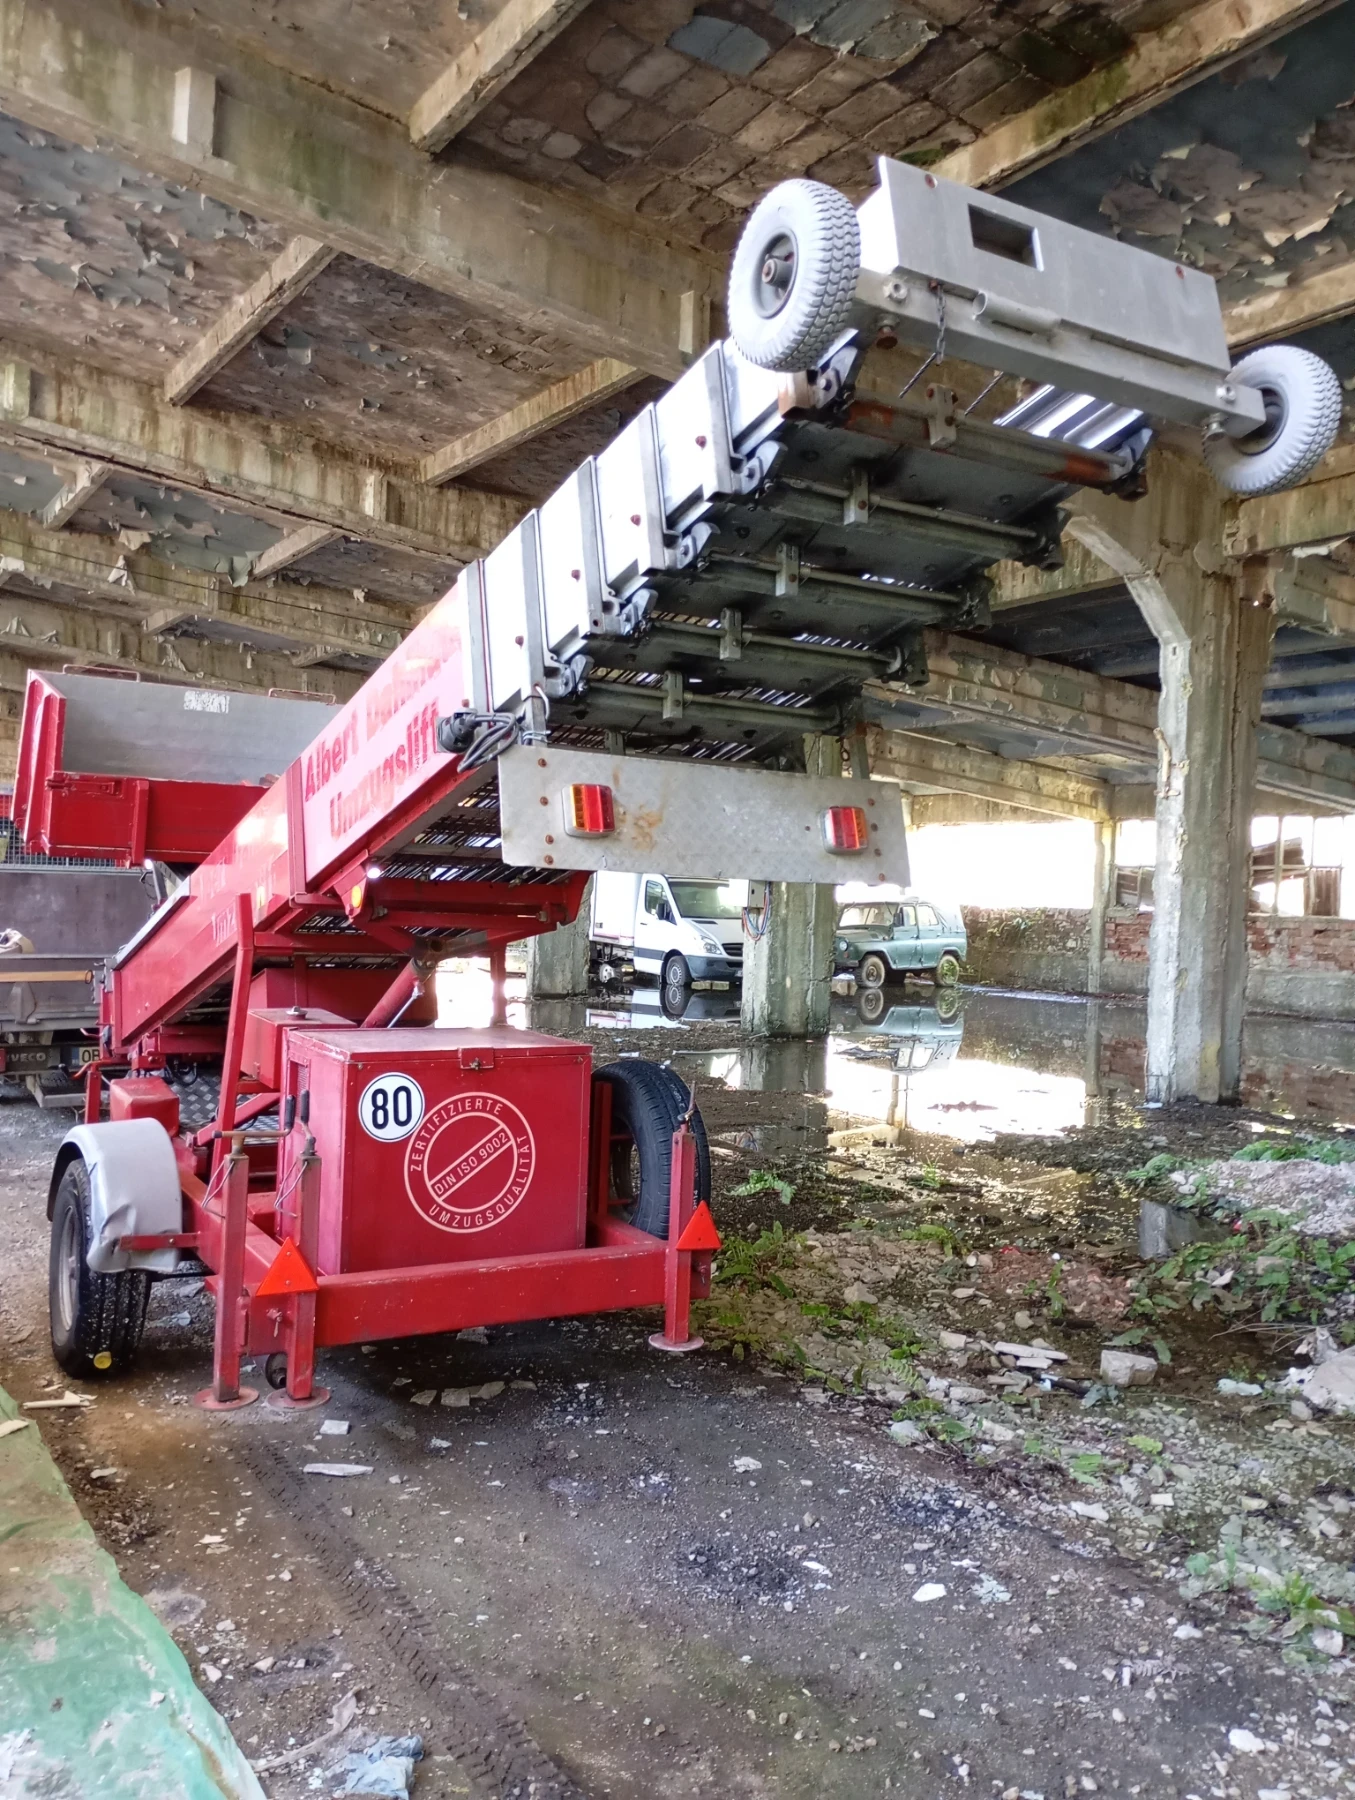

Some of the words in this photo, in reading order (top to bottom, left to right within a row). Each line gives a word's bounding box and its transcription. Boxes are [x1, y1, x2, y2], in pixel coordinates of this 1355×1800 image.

[305, 709, 359, 801] Albert
[330, 697, 439, 839] Umzugslift
[371, 1085, 412, 1130] 80
[410, 1098, 504, 1172] ZERTIFIZIERTE
[429, 1134, 530, 1228] UMZUGSQUALITÄT
[434, 1174, 457, 1196] DIN
[457, 1157, 478, 1177] ISO
[479, 1132, 509, 1158] 9002
